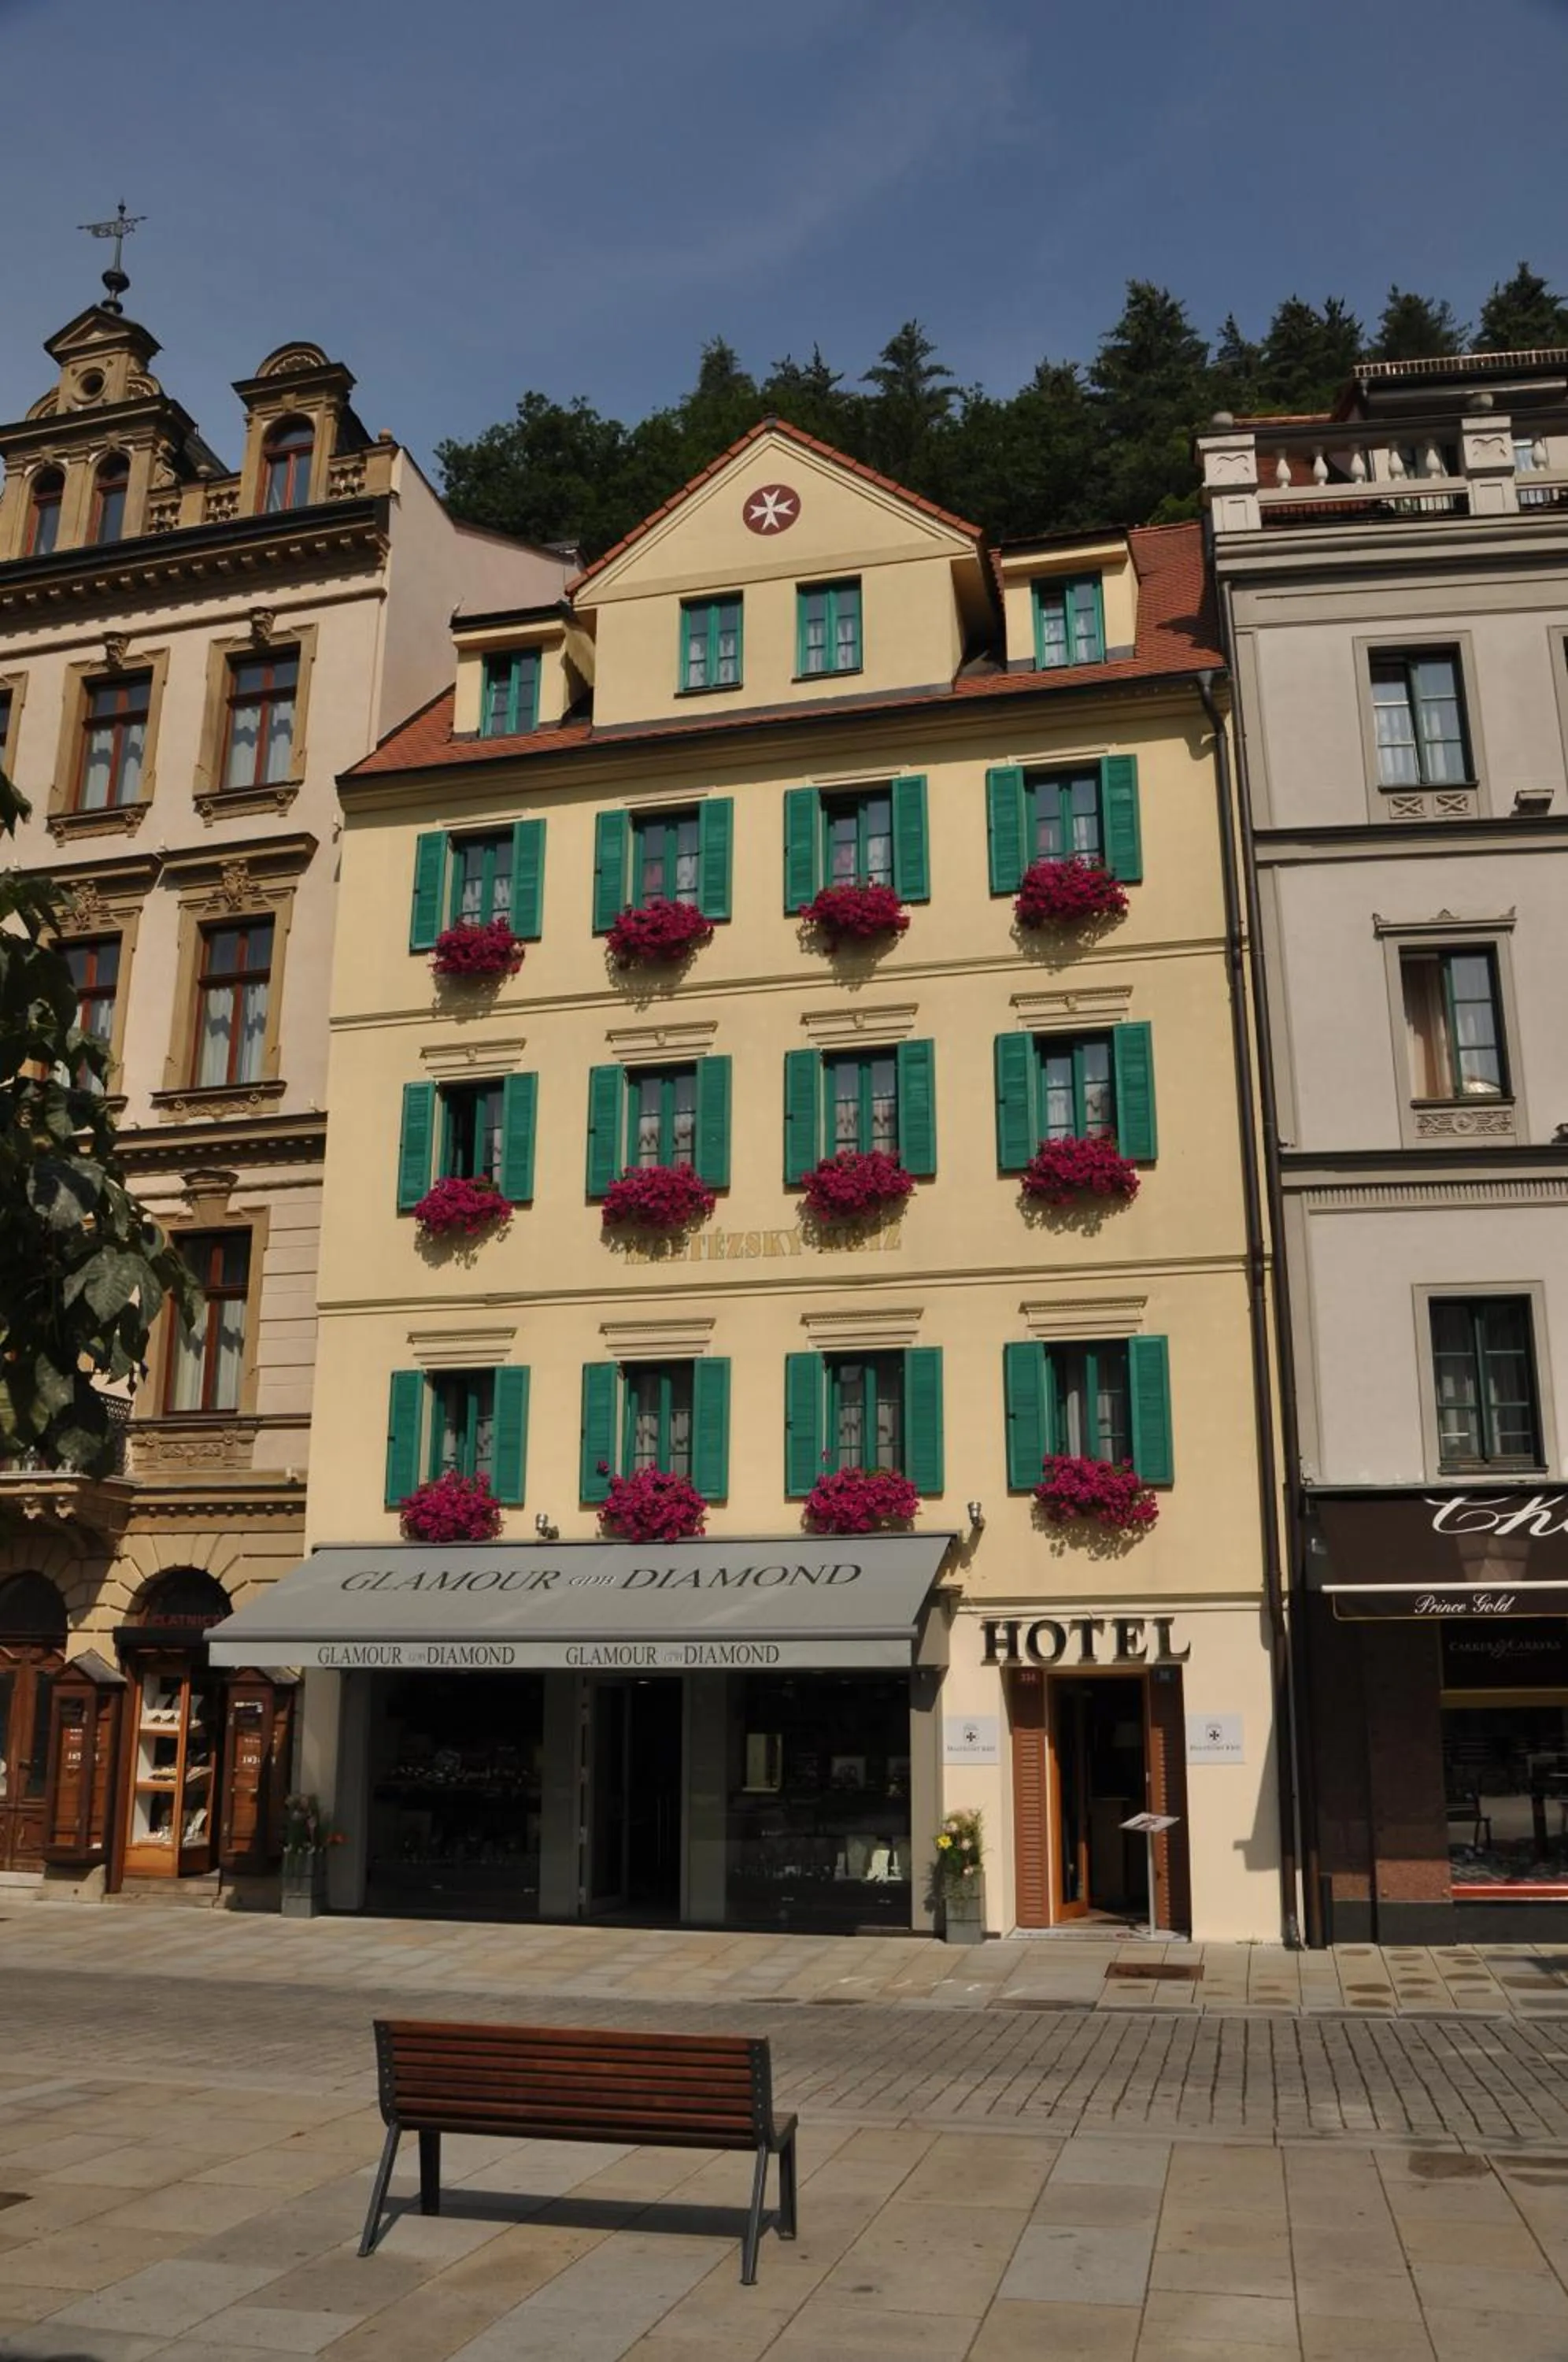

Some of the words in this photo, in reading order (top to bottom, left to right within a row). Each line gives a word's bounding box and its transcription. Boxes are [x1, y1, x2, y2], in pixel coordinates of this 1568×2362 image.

[624, 1224, 802, 1264] TÉZSKÝ
[341, 1570, 560, 1591] GLAMOUR
[619, 1564, 862, 1590] DIAMOND
[1414, 1594, 1466, 1613] Prince
[1473, 1592, 1515, 1613] Gold
[981, 1616, 1191, 1666] HOTEL
[317, 1646, 403, 1665] GLAMOUR
[427, 1646, 516, 1665] DIAMOND
[565, 1646, 656, 1665] GLAMOUR
[683, 1644, 780, 1664] DIAMOND
